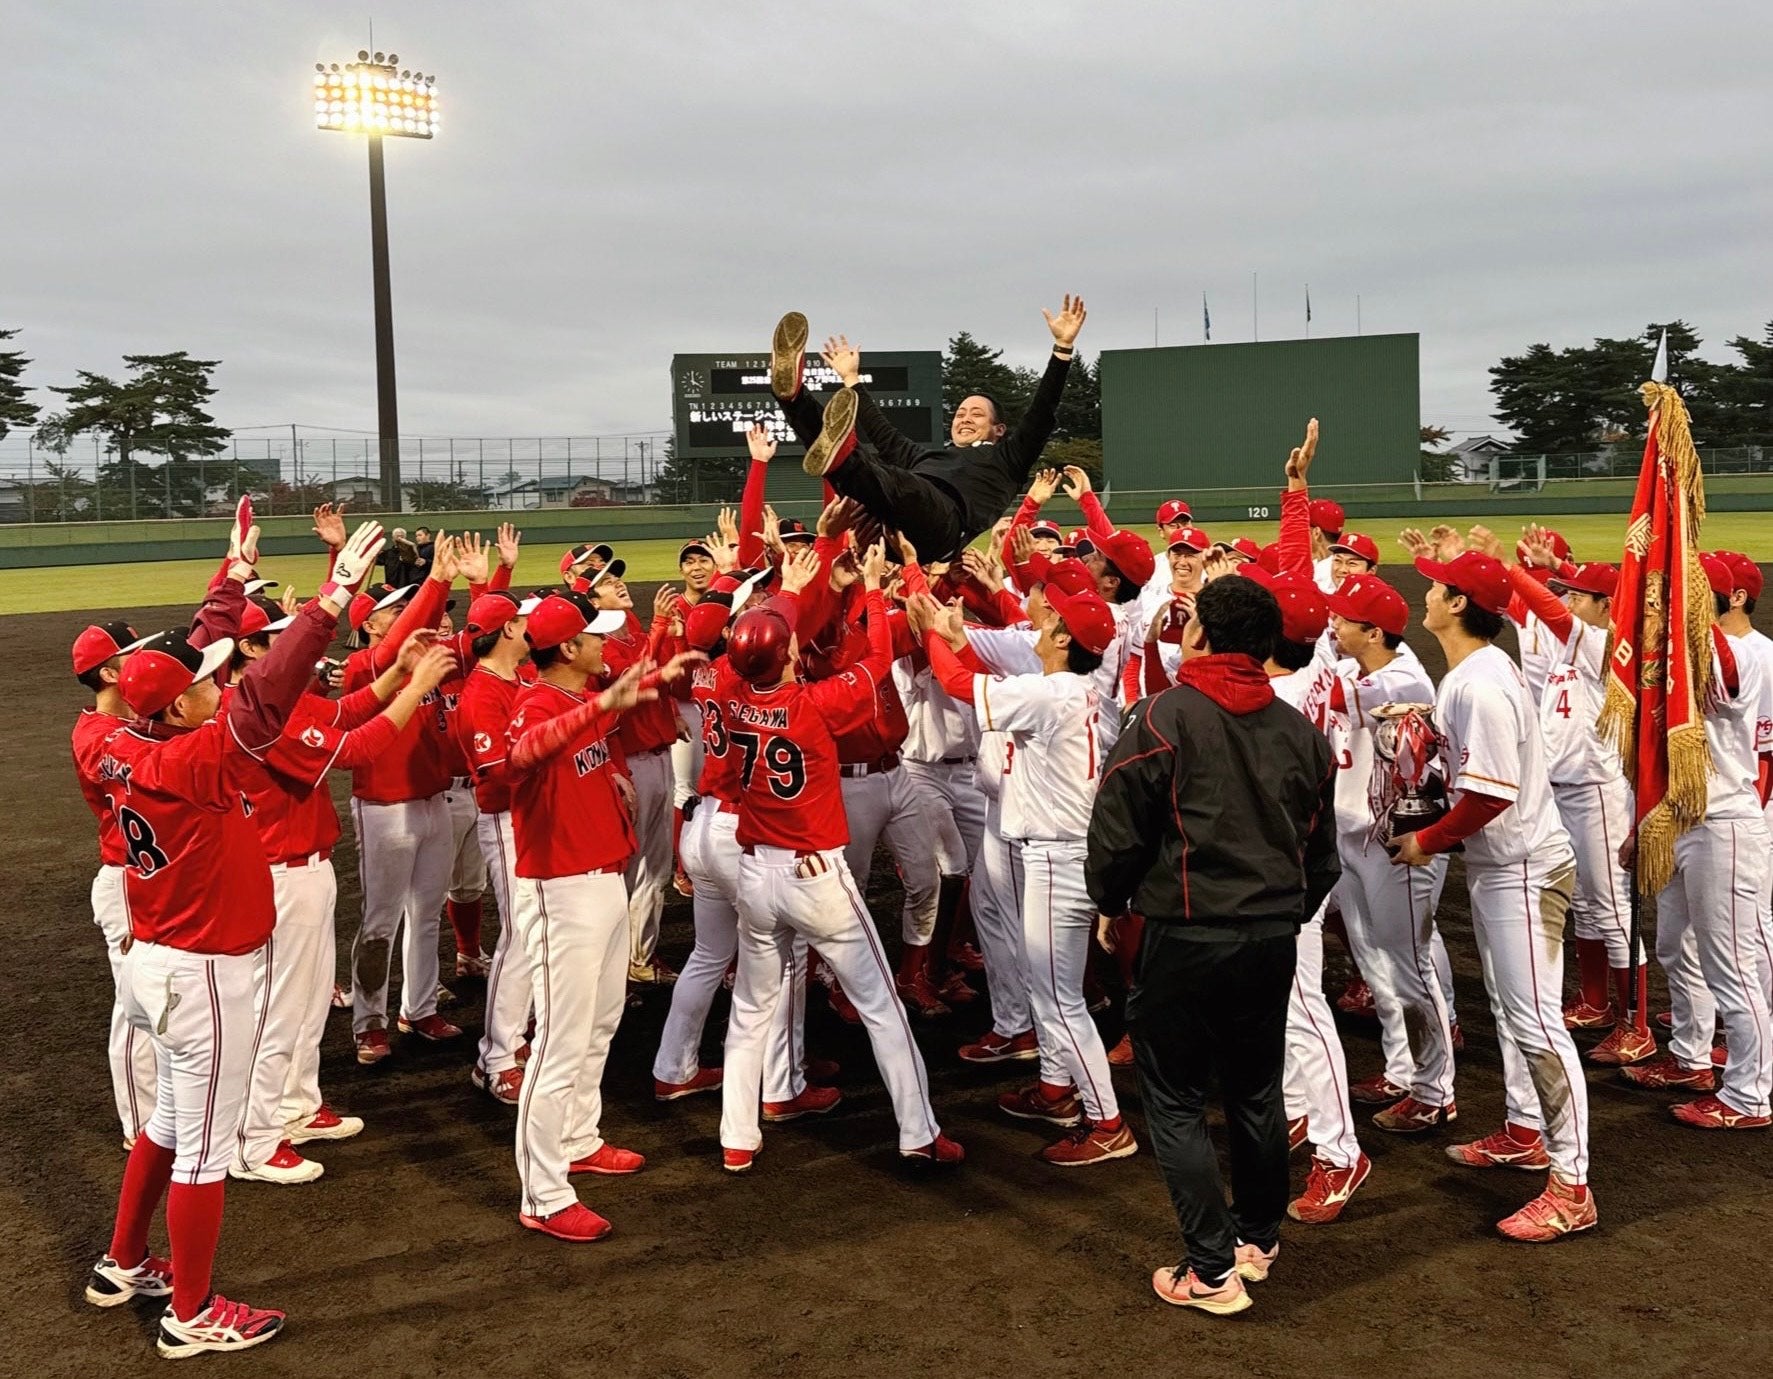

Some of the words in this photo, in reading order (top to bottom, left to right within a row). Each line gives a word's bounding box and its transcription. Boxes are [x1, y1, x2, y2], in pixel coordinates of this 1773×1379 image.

[715, 361, 738, 369] TEAM
[702, 402, 706, 410] 1
[710, 402, 715, 410] 2
[719, 402, 725, 410] 3
[728, 402, 734, 410] 4
[738, 402, 743, 410] 5
[746, 402, 752, 410] 6
[755, 402, 761, 410] 7
[764, 402, 770, 410] 8
[888, 399, 894, 407] 6
[897, 399, 902, 407] 7
[906, 399, 911, 407] 8
[914, 398, 920, 406] 9
[1170, 501, 1180, 512] T
[1248, 507, 1269, 518] 120
[1068, 531, 1079, 544] T
[1181, 529, 1192, 541] T
[1347, 534, 1358, 547] T
[1555, 689, 1572, 719] 4
[727, 700, 789, 730] SEGAWA
[728, 729, 807, 800] 79
